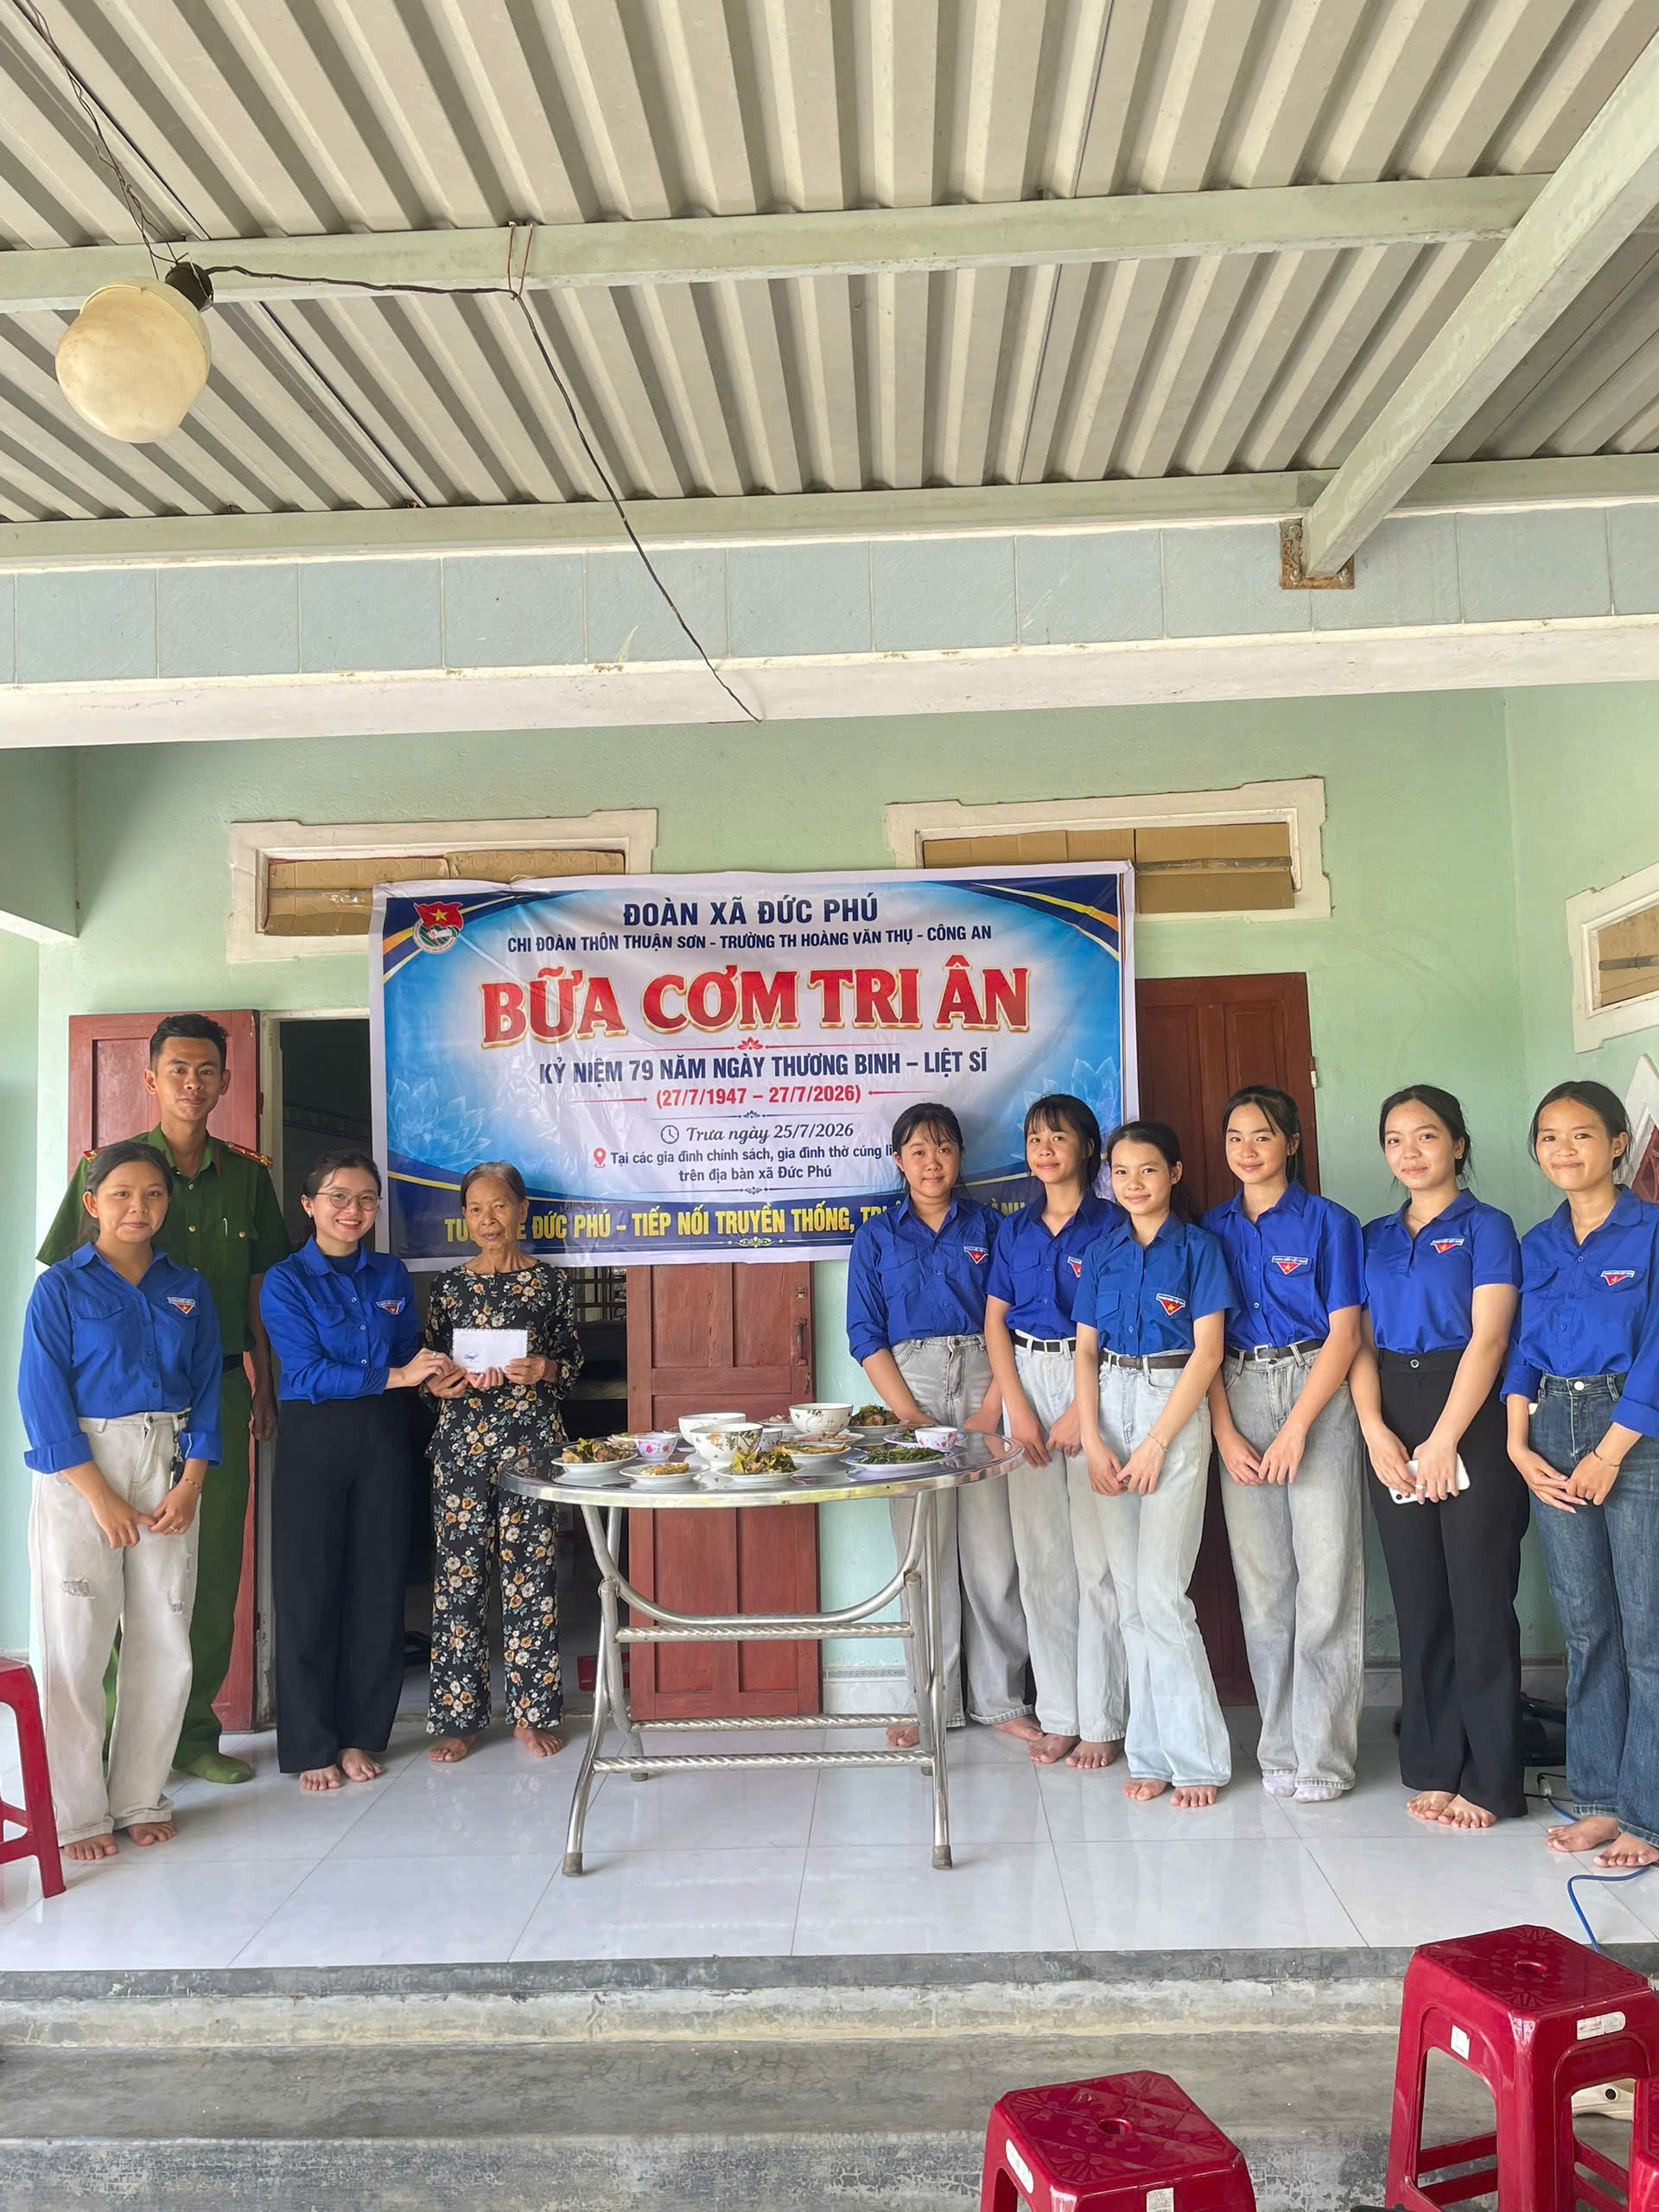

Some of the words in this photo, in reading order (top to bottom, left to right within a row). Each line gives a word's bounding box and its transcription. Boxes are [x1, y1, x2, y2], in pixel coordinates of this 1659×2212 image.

[623, 897, 698, 927] ĐOÀN
[709, 895, 747, 925] XÃ
[757, 893, 812, 925] ĐỨC
[823, 892, 878, 923] PHÚ
[507, 937, 531, 952] CHI
[536, 933, 576, 952] ĐOÀN
[581, 932, 619, 951] THÔN
[623, 932, 672, 951] THUẬN
[677, 934, 706, 949] SƠN
[720, 931, 775, 949] TRƯỜNG
[779, 934, 797, 948] TH
[801, 931, 849, 947] HOÀNG
[852, 929, 882, 944] VĂN
[886, 929, 913, 944] THỤ
[927, 924, 967, 941] CÔNG
[970, 925, 992, 939] AN
[480, 965, 629, 1049] BỮA
[640, 963, 801, 1034] CƠM
[807, 967, 923, 1029] TRI
[932, 953, 1031, 1032] ÂN
[539, 1056, 567, 1084] KỶ
[573, 1058, 623, 1088] NIỆM
[628, 1059, 654, 1082] 79
[659, 1054, 707, 1080] NĂM
[713, 1053, 766, 1079] NGÀY
[771, 1052, 849, 1077] THƯƠNG
[855, 1052, 900, 1076] BINH
[924, 1047, 963, 1077] LIỆT
[969, 1046, 988, 1073] SĨ
[656, 1088, 747, 1109] (27/7/1947
[768, 1084, 861, 1104] 27/7/2026)
[686, 1127, 725, 1141] Trưa
[728, 1126, 770, 1145] ngày
[773, 1123, 854, 1140] 25/7/2026
[610, 1152, 629, 1166] Tại
[632, 1151, 653, 1164] các
[657, 1152, 675, 1166] gia
[677, 1149, 704, 1163] đình
[707, 1148, 739, 1162] chính
[742, 1147, 773, 1162] sách,
[778, 1147, 796, 1162] gia
[799, 1146, 825, 1159] đình
[829, 1145, 849, 1158] thờ
[853, 1144, 882, 1160] cúng
[679, 1169, 704, 1182] trên
[709, 1167, 728, 1184] địa
[731, 1166, 754, 1180] bàn
[759, 1166, 773, 1179] xã
[778, 1166, 804, 1179] Đức
[807, 1164, 832, 1178] Phú
[531, 1211, 568, 1239] ĐỨC
[574, 1208, 611, 1238] PHÚ
[631, 1205, 671, 1236] TIẾP
[677, 1204, 709, 1236] NỐI
[715, 1202, 785, 1234] TRUYỀN
[791, 1200, 855, 1234] THỐNG,
